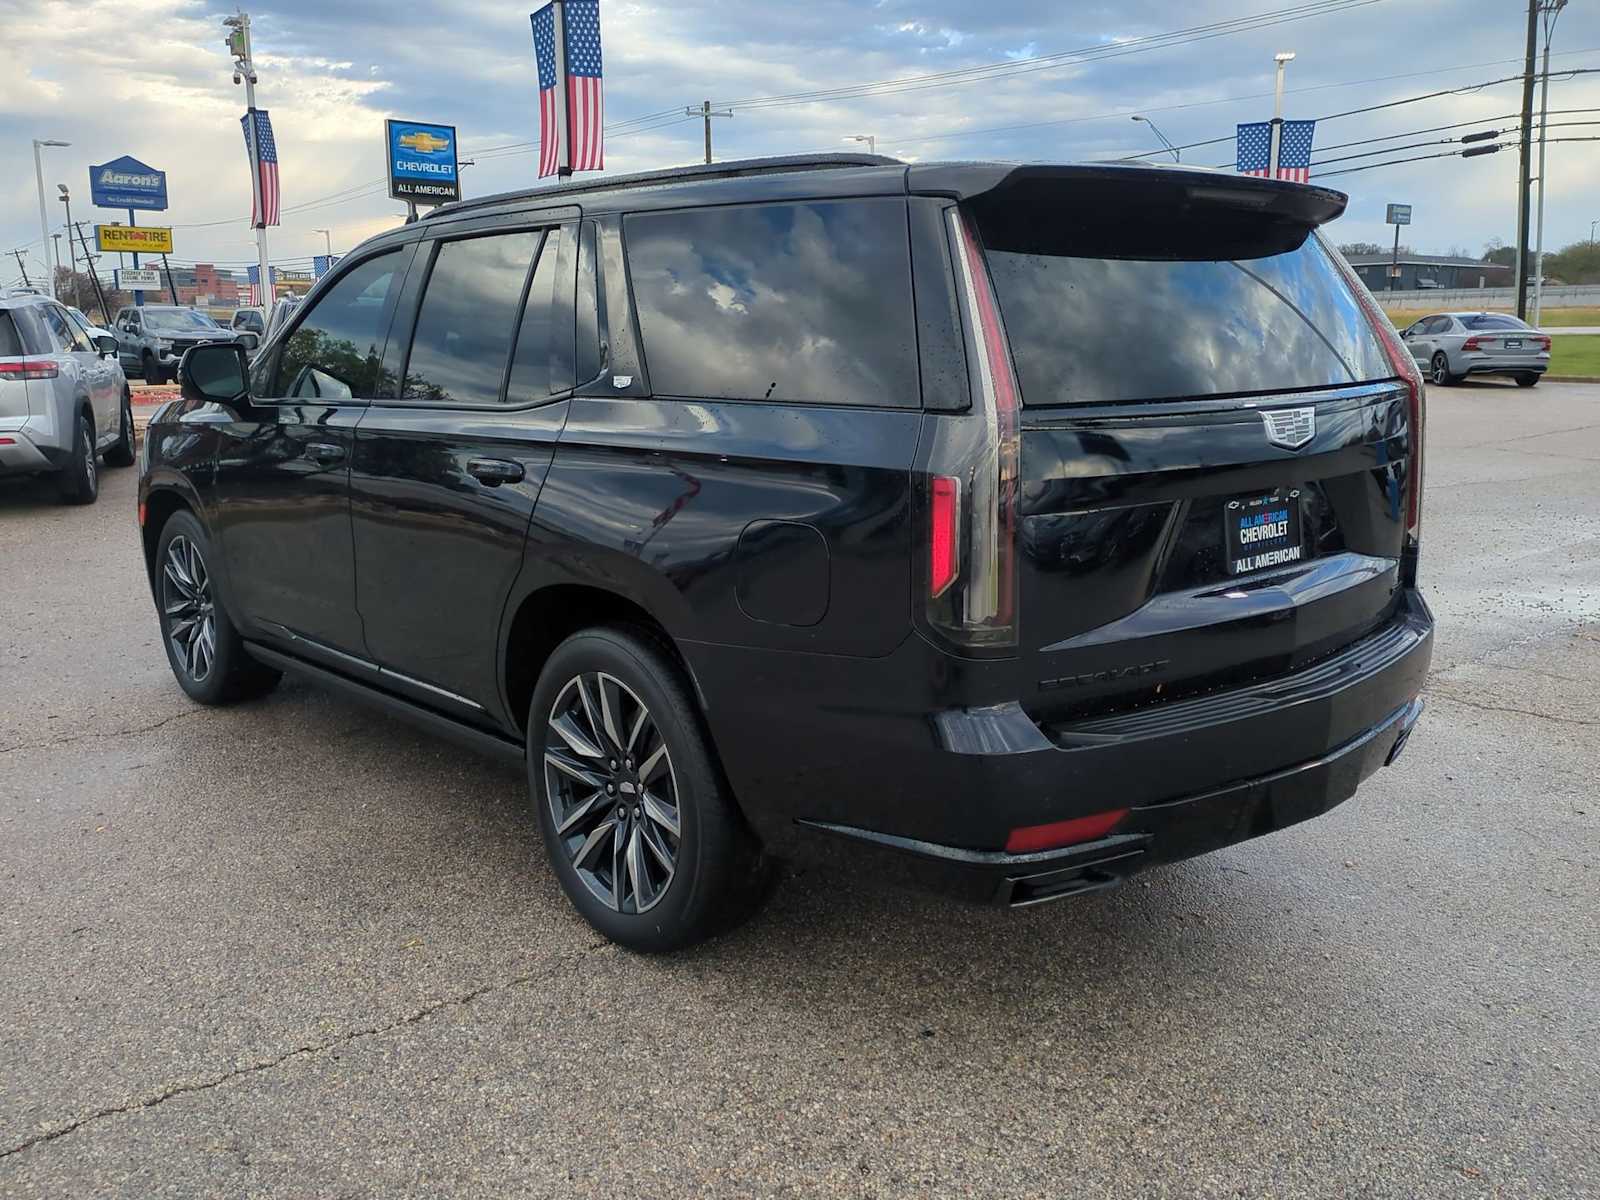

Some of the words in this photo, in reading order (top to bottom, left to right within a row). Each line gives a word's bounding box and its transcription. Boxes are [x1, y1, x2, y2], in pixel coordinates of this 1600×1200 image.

[396, 160, 453, 174] CHEVROLET
[101, 169, 159, 187] Aaron's
[398, 183, 413, 193] ALL
[415, 185, 455, 196] AMERICAN
[1240, 516, 1254, 528] ALL
[1254, 509, 1288, 526] AMERICAN
[1240, 520, 1288, 544] CHEVROLET
[1236, 557, 1254, 574] ALL
[1255, 546, 1300, 569] AMERICAN
